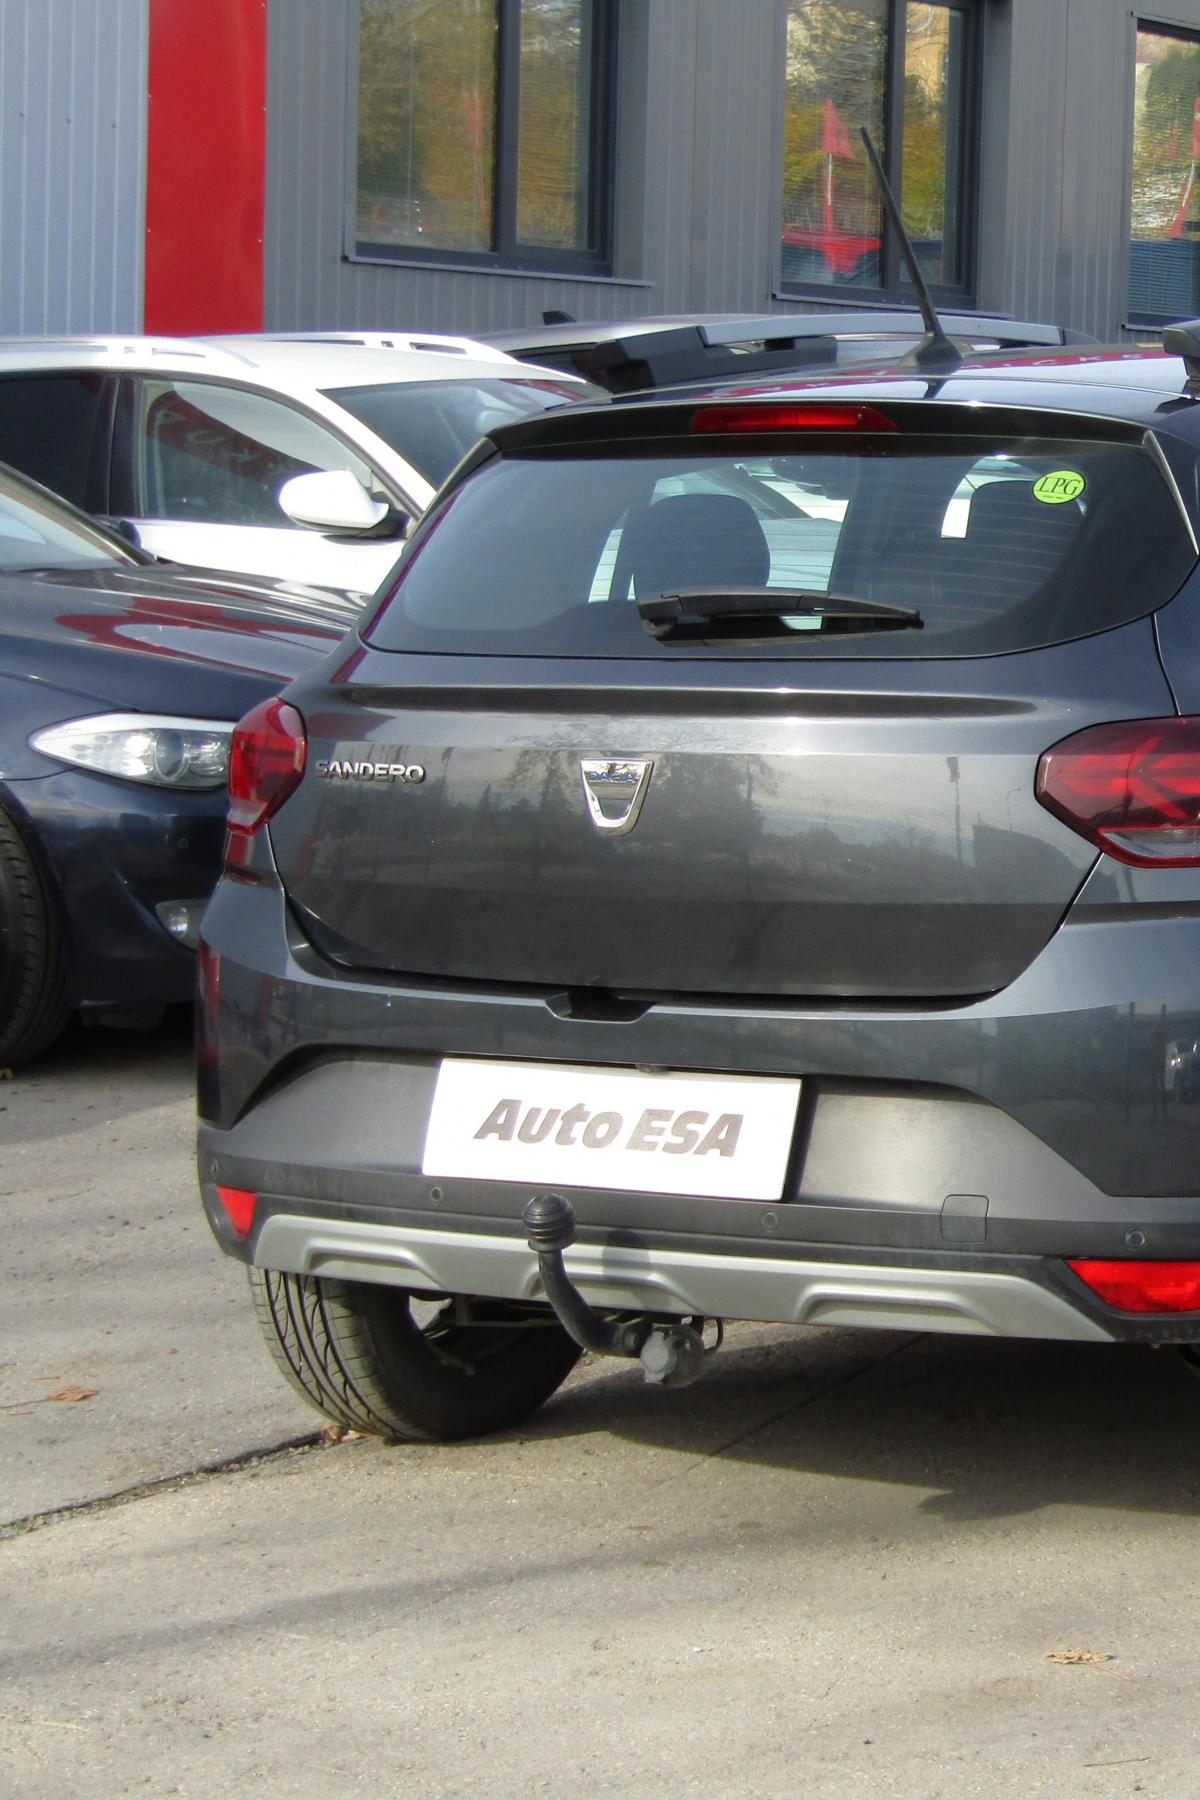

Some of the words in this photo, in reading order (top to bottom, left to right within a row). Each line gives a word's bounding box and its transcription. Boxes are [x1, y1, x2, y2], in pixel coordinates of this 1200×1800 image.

[1036, 476, 1081, 496] LPG
[315, 760, 427, 785] SANDERO
[473, 1098, 624, 1150] Auto
[625, 1107, 744, 1158] ESA
